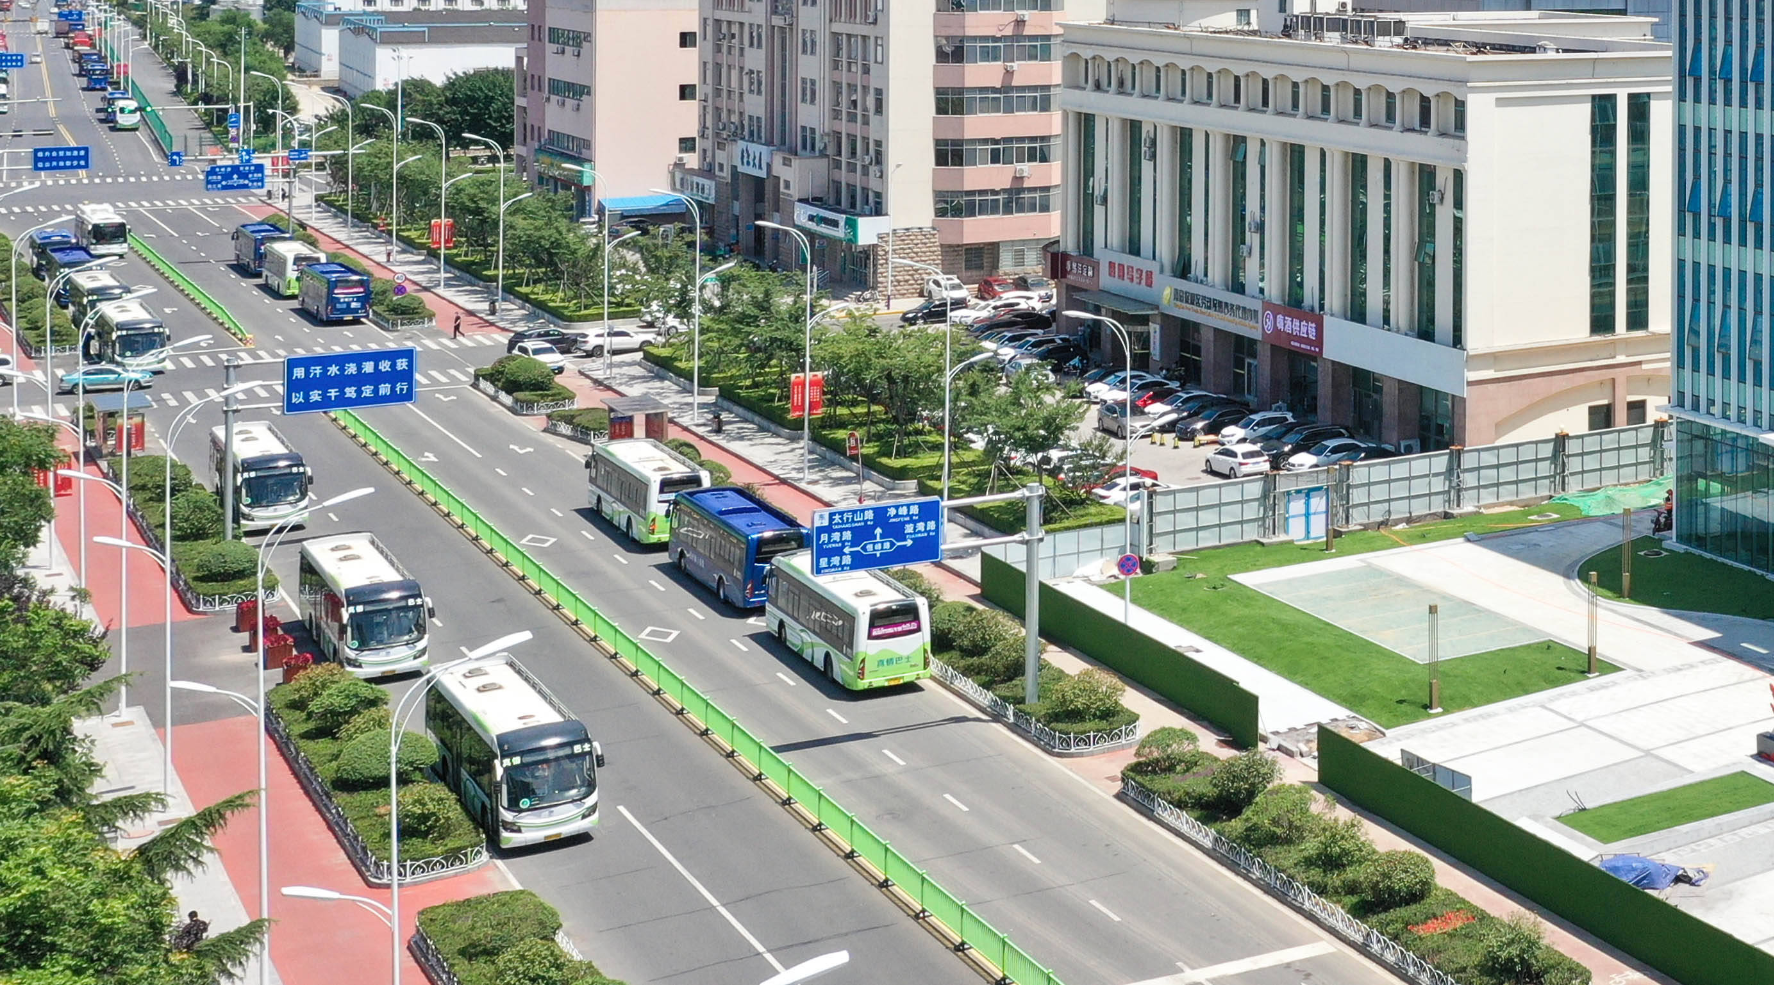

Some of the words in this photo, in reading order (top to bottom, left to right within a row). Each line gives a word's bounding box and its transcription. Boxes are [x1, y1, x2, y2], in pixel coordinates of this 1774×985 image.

[1276, 313, 1317, 340] 嗨酒供应链
[292, 358, 409, 380] 用汗水浇灌收获
[291, 382, 409, 404] 以实干笃定前行
[832, 510, 874, 524] 太行山路
[887, 505, 919, 517] 净峰路
[819, 530, 852, 544] 月湾路
[818, 555, 852, 568] 星湾路
[502, 756, 521, 768] 真情
[573, 742, 592, 754] 巴士
